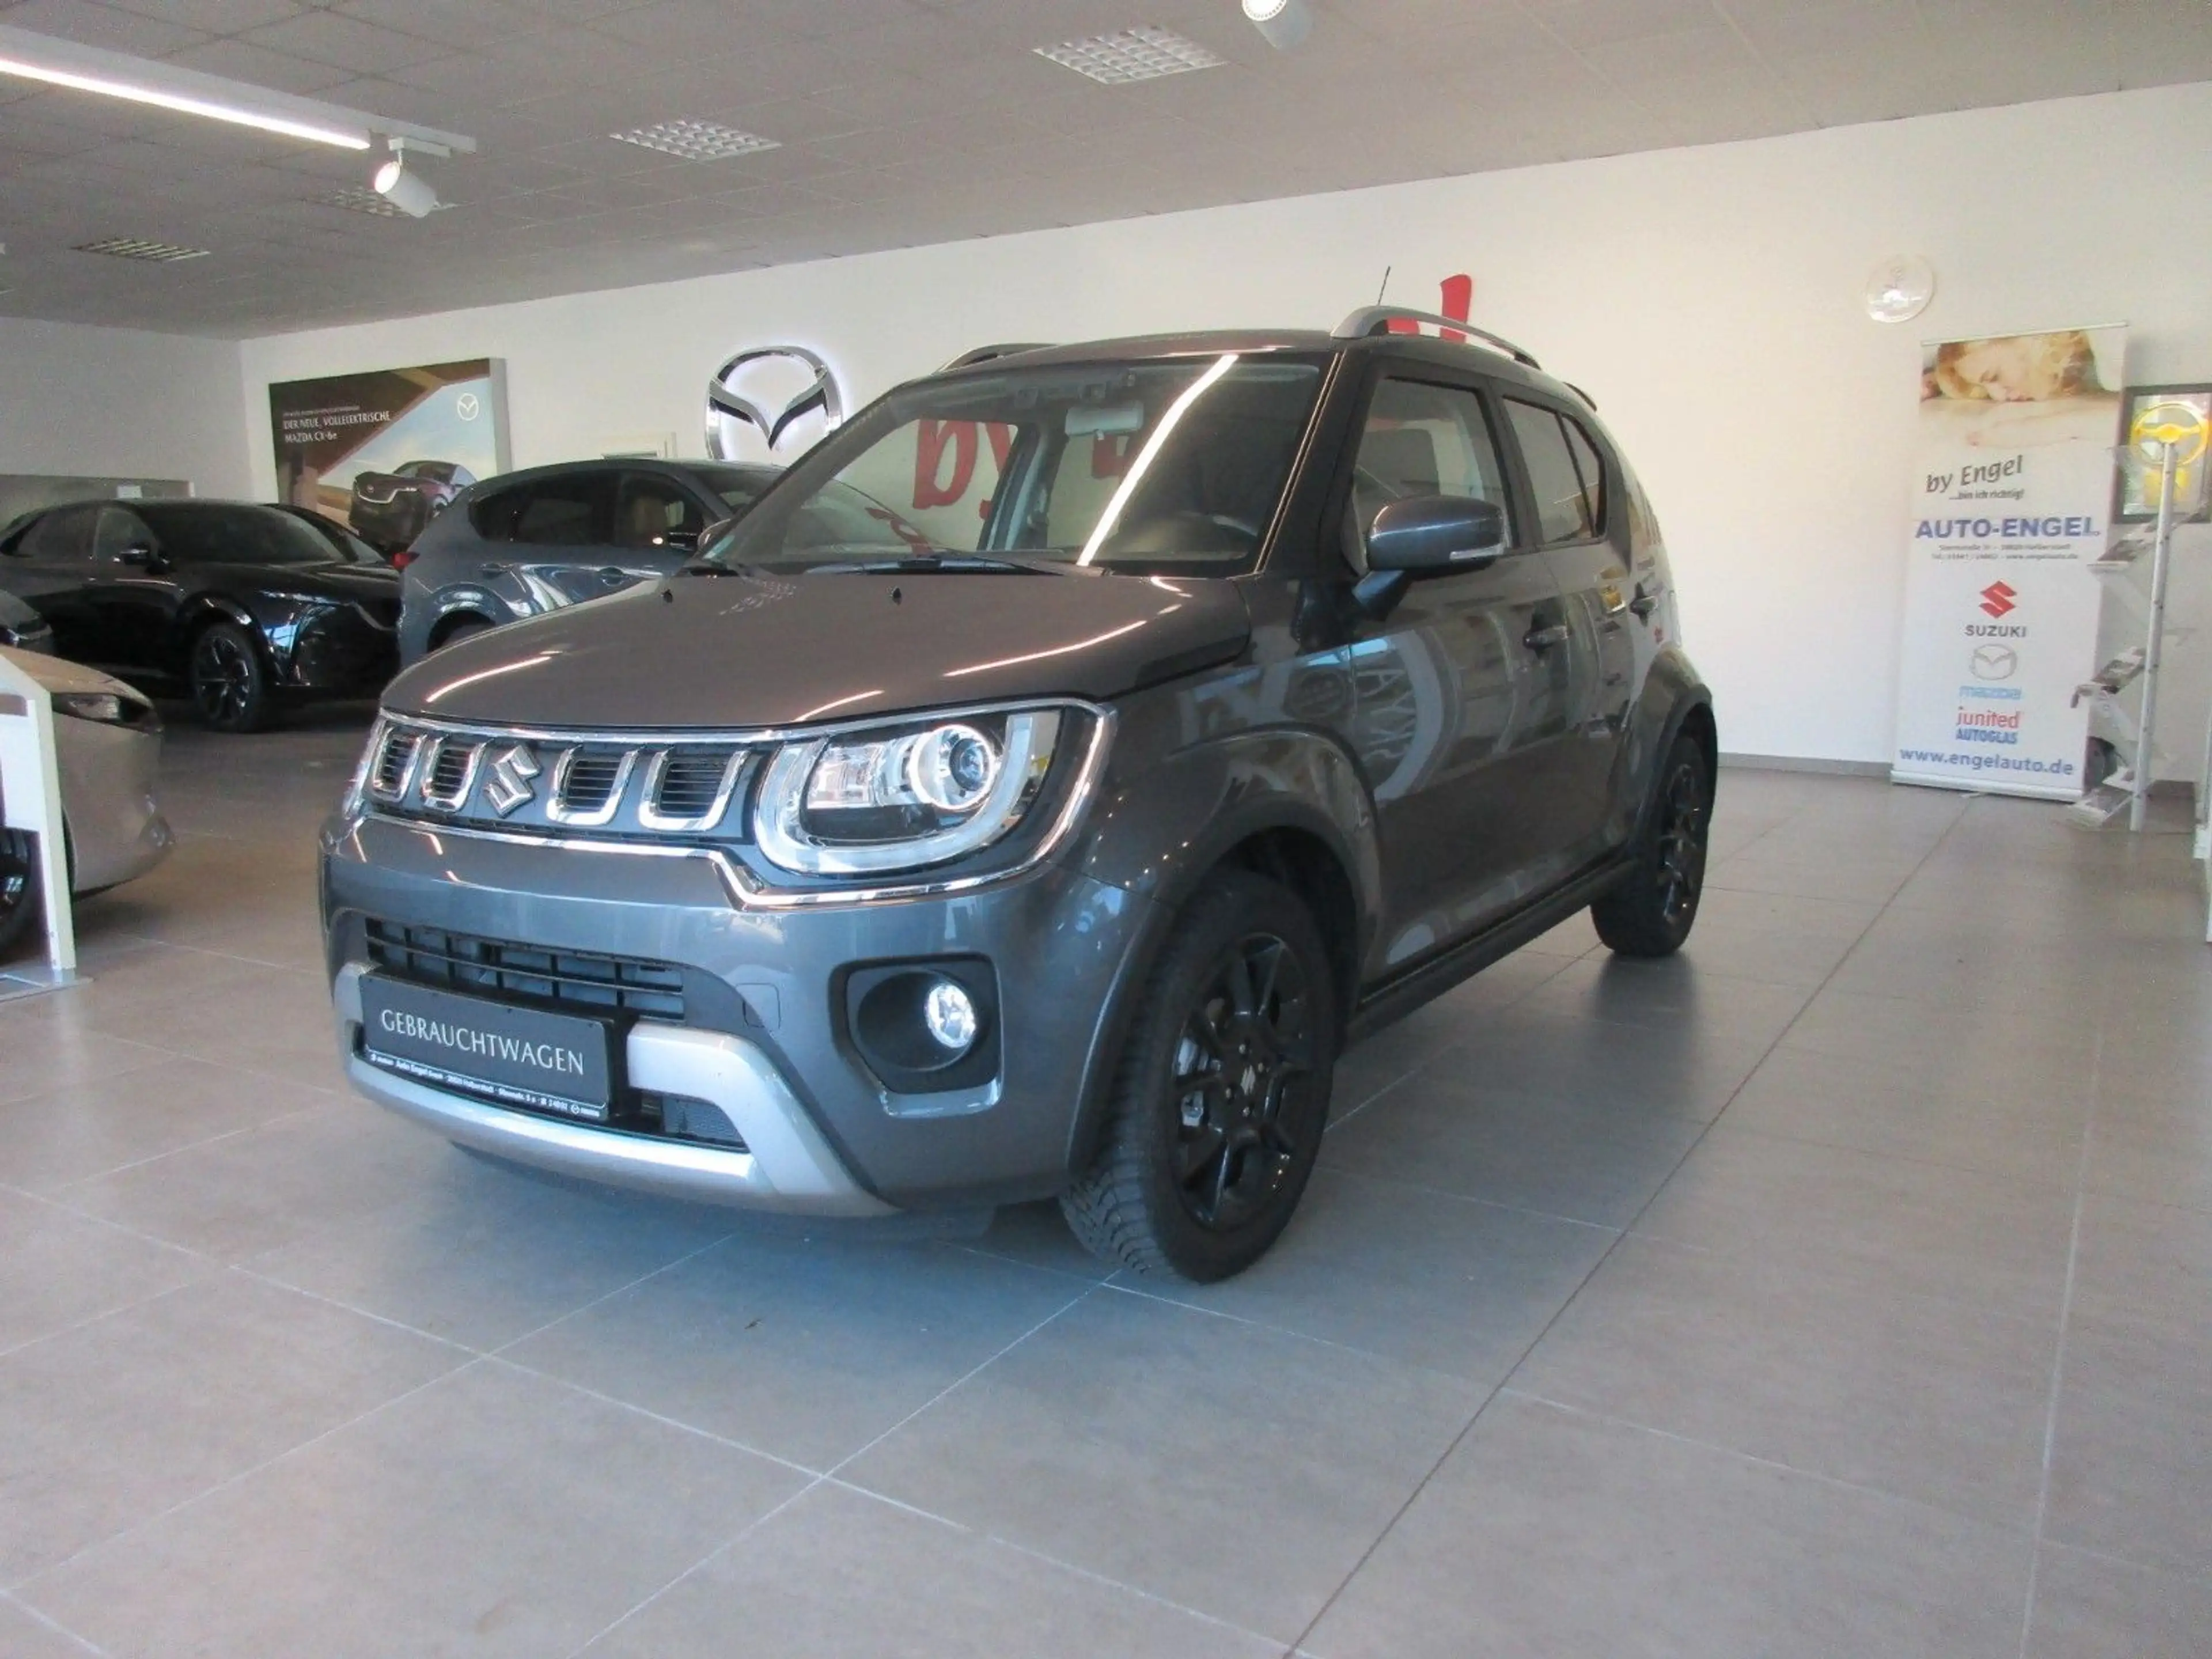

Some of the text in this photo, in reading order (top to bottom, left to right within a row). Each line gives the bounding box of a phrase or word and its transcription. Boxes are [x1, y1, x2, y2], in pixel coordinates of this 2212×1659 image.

[1925, 454, 2023, 493] by Engel
[1964, 624, 2027, 638] SUZUKI
[1956, 706, 2022, 729] junited
[1956, 728, 2018, 745] AUTOGLAS
[1899, 749, 2074, 775] www.engelauto.de
[381, 1009, 584, 1075] GEBRAUCHTWAGEN
